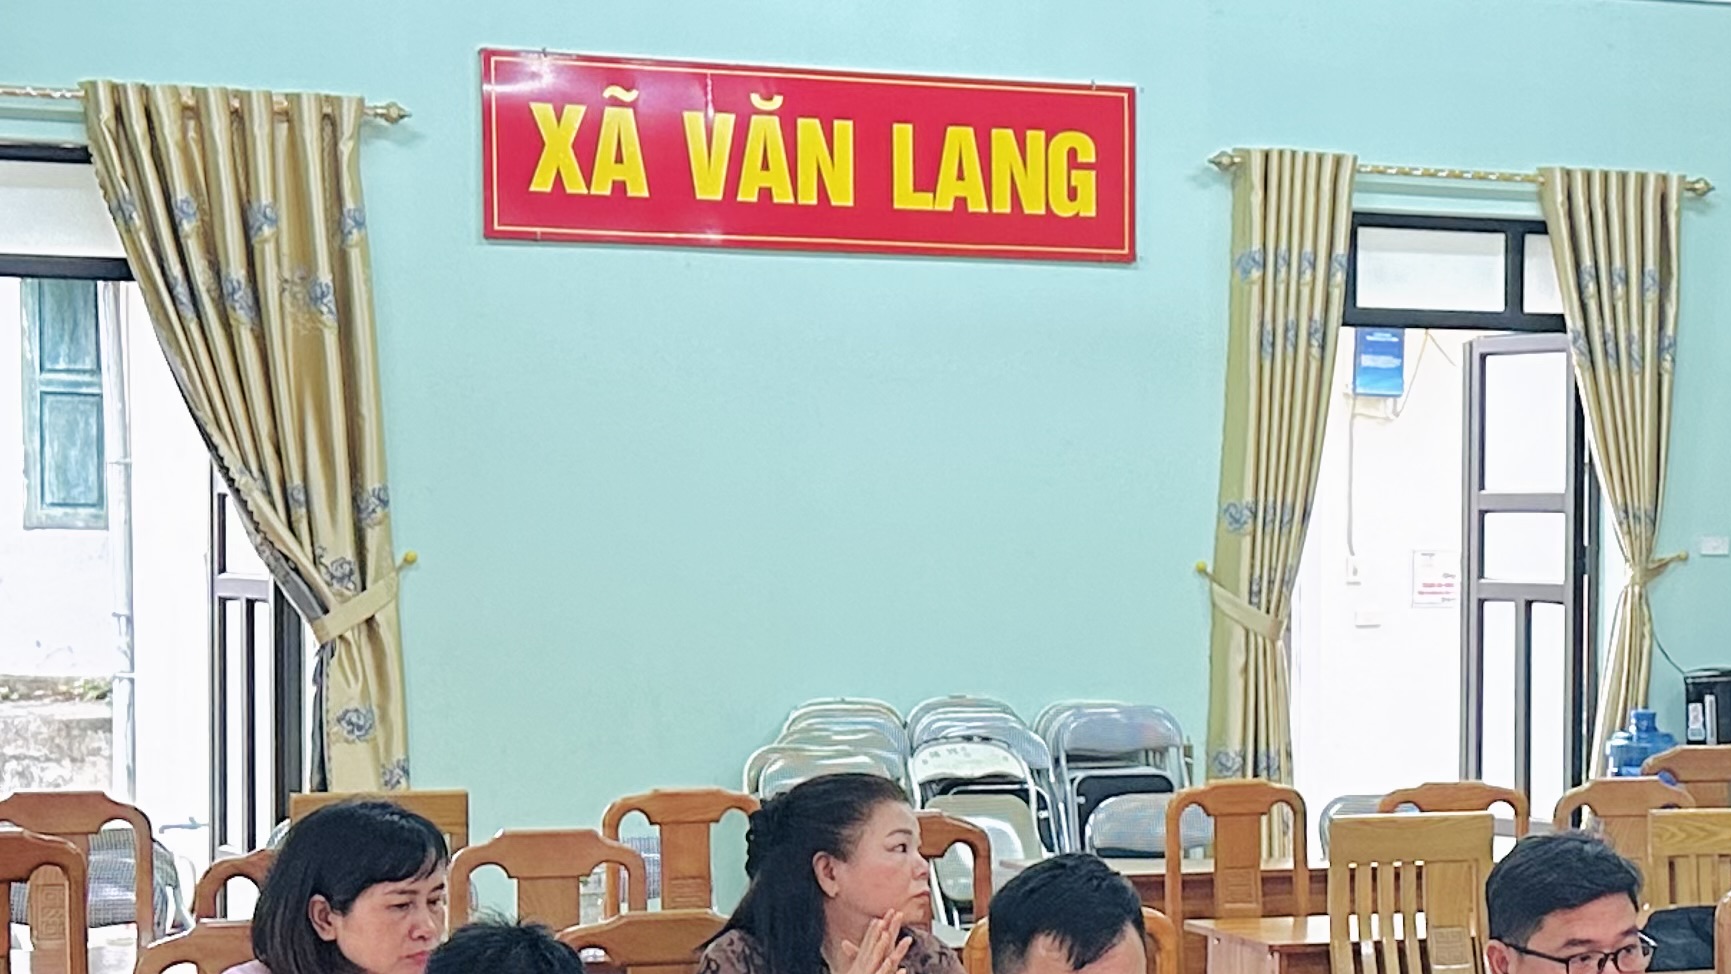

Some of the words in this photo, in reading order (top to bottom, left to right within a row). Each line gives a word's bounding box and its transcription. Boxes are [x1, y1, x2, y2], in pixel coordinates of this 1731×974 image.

[529, 86, 649, 197] XÃ
[682, 95, 853, 206] VĂN
[893, 123, 1096, 217] LANG
